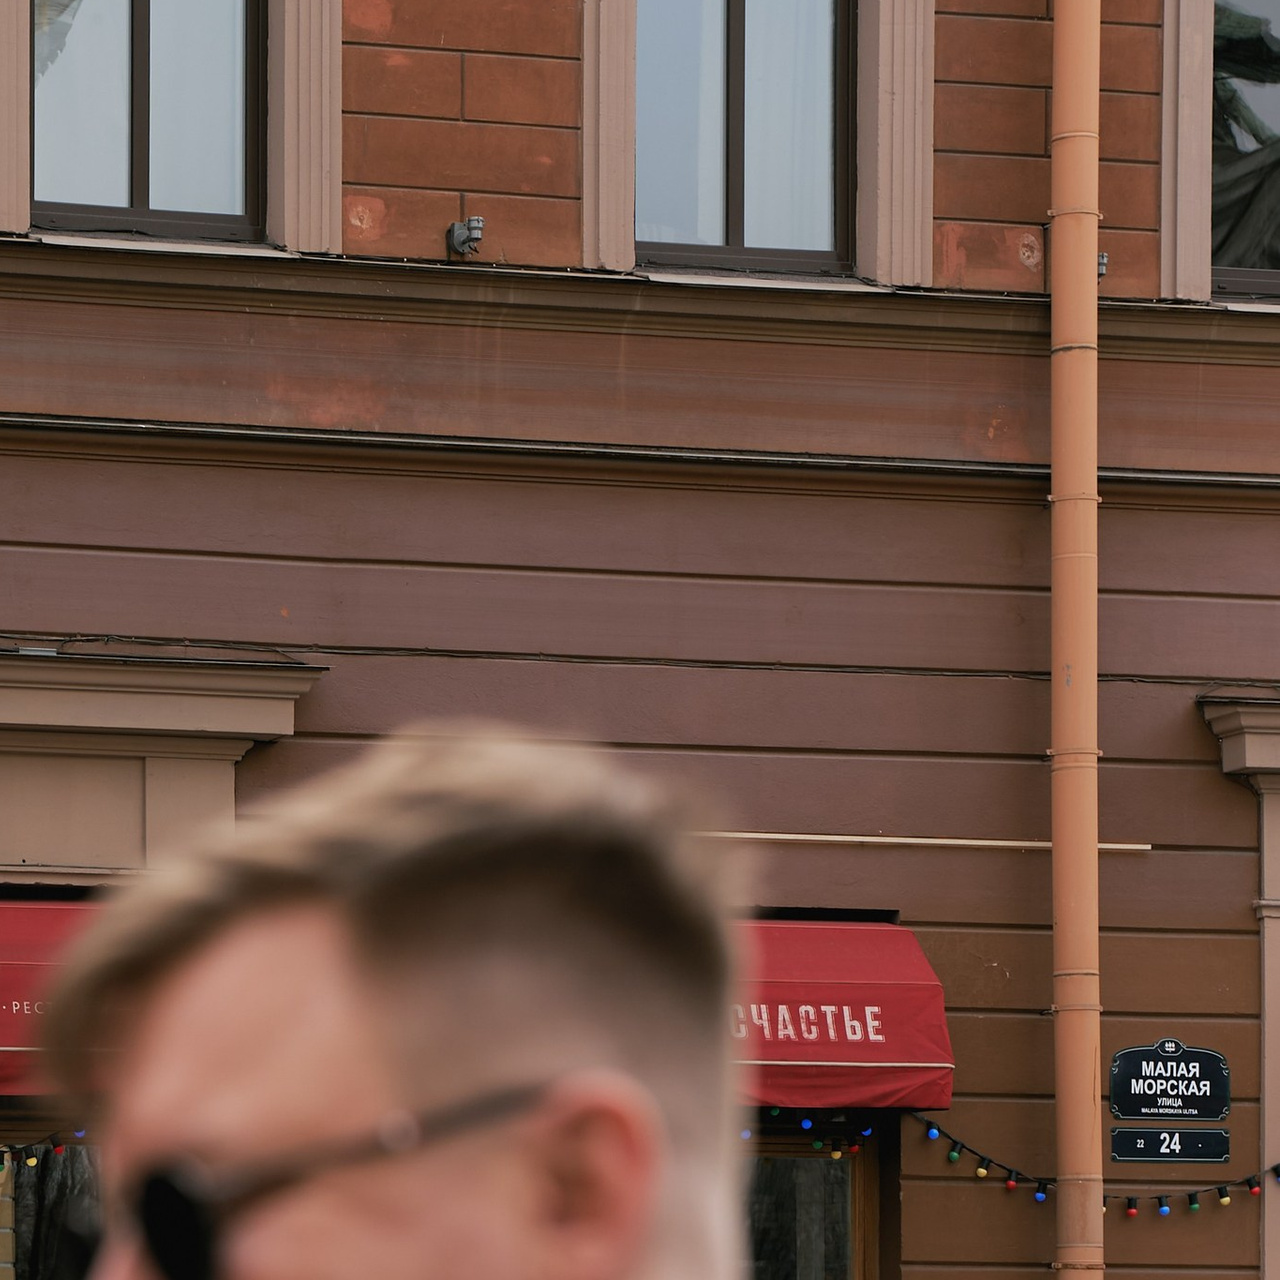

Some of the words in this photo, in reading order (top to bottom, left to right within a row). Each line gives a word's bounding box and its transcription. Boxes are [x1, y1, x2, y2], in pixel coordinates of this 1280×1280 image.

[729, 1003, 886, 1043] СЧАСТЬЕ
[1141, 1060, 1200, 1078] МАЛАЯ
[1131, 1079, 1211, 1096] МОРСКАЯ
[1157, 1097, 1183, 1108] УЛИЦА
[1136, 1138, 1145, 1148] 22
[1159, 1132, 1182, 1154] 24
